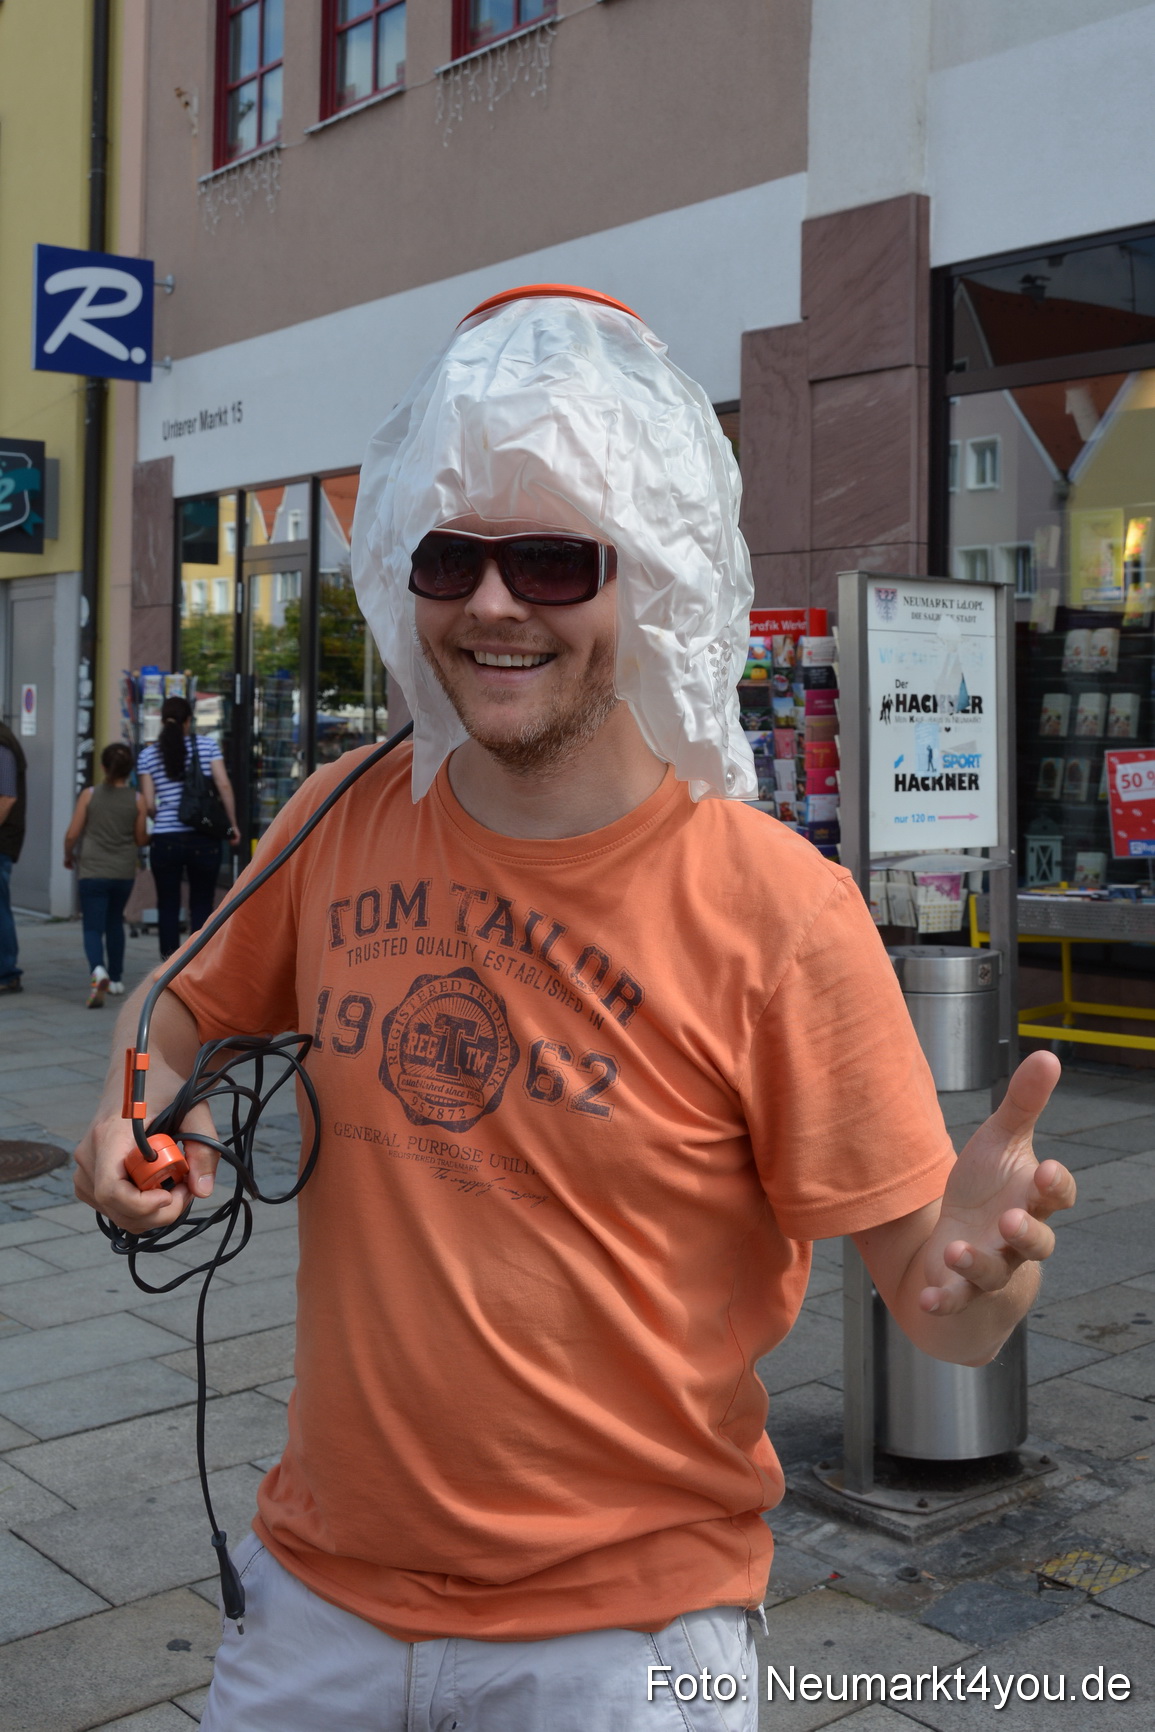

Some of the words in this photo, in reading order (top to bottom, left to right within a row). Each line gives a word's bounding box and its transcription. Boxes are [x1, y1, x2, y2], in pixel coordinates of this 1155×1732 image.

[162, 419, 197, 441] Unterer
[199, 408, 228, 432] Markt
[231, 401, 243, 424] 15
[903, 595, 955, 610] NEUMARKT
[895, 679, 908, 689] Der
[895, 693, 983, 715] HACKR
[942, 753, 982, 769] SPORT
[894, 772, 980, 792] HACKNER
[1121, 773, 1143, 790] 50
[894, 815, 908, 824] nur
[911, 813, 926, 823] 120
[927, 814, 936, 823] m
[328, 878, 433, 950] TOM
[449, 879, 646, 1030] TAILOR
[346, 935, 408, 968] TRUSTED
[416, 935, 478, 962] QUALITY
[482, 949, 584, 1014] ESTABLISHED
[588, 1013, 606, 1032] IN
[312, 985, 376, 1060] 19
[388, 978, 462, 1067] REGISTERED
[468, 982, 510, 1092] TRADEMARK
[522, 1035, 622, 1123] 62
[444, 1085, 466, 1098] since
[411, 1096, 467, 1121] 957872
[333, 1121, 400, 1149] GENERAL
[407, 1134, 484, 1164] PURPOSE
[387, 1150, 436, 1165] REGISTERED
[436, 1157, 480, 1173] TRADEMARK
